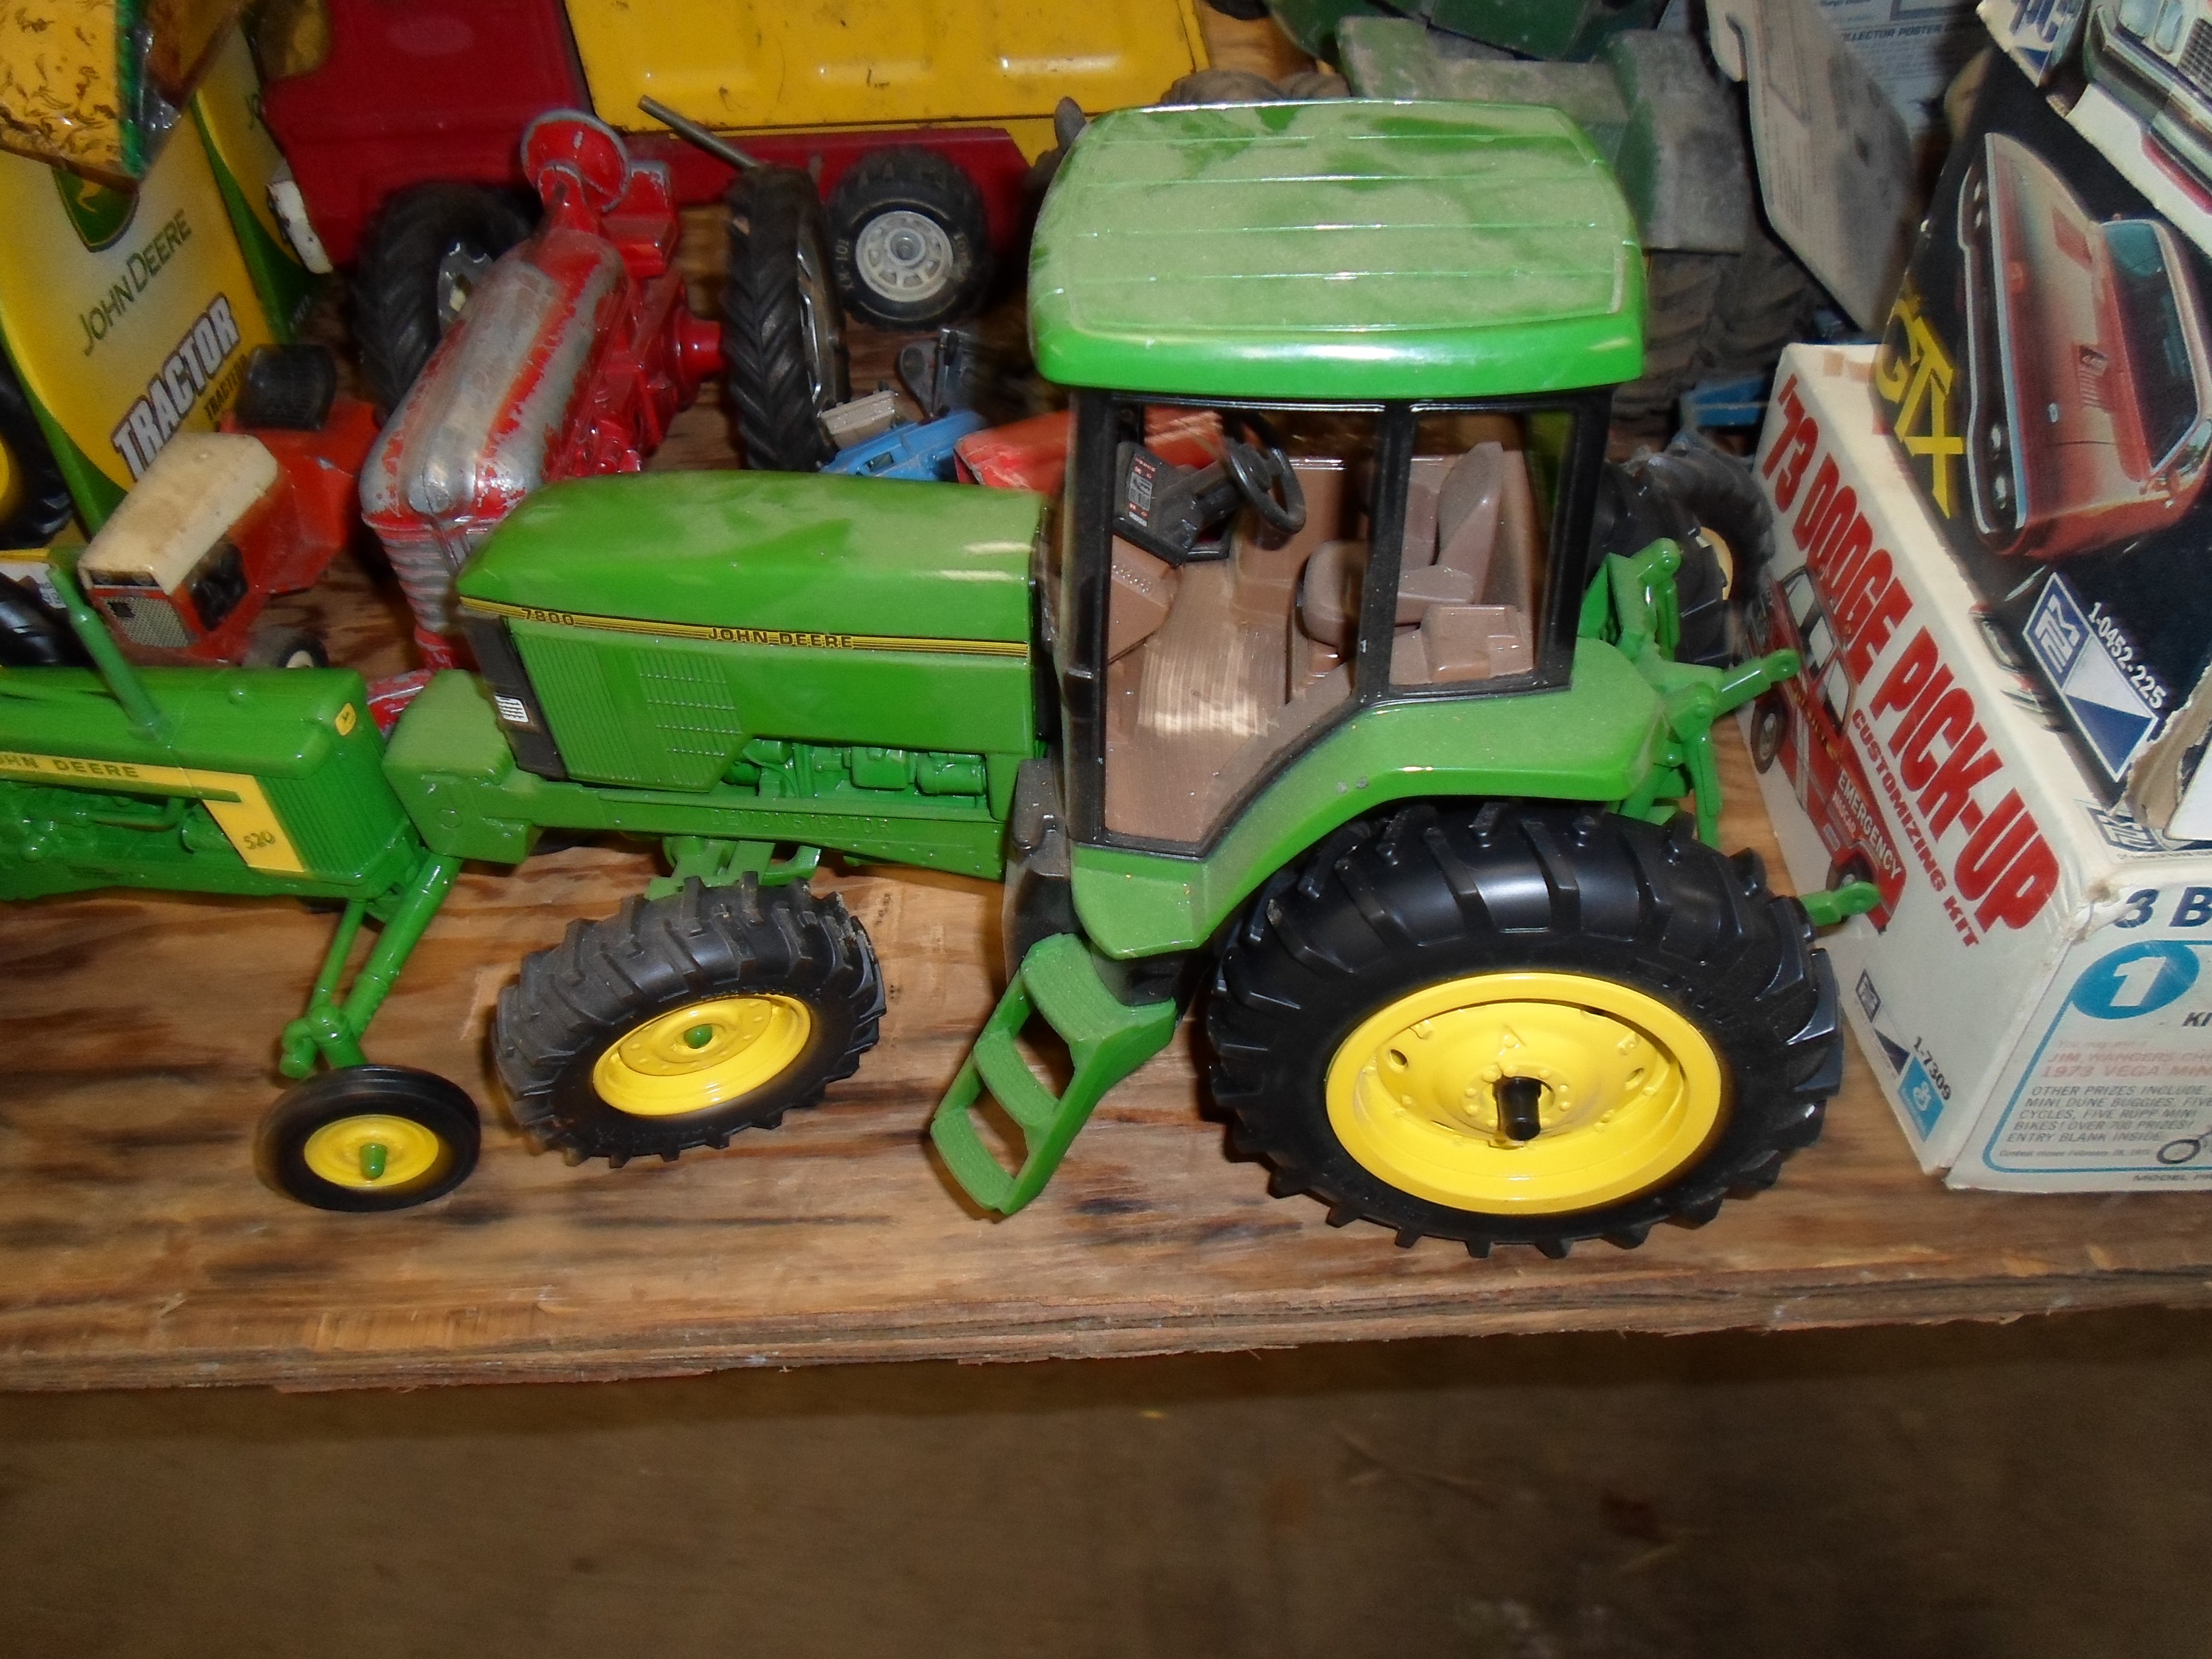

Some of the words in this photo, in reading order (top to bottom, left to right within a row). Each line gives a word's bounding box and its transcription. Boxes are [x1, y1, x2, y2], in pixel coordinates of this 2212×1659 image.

[79, 275, 134, 357] JOHN
[127, 208, 192, 292] DEERE
[110, 291, 240, 483] TRACTOR
[521, 608, 575, 626] 7800
[708, 627, 769, 643] JOHN
[780, 632, 854, 649] DEERE
[1762, 373, 1819, 514] '73
[1792, 452, 1913, 685] DODGE
[1869, 626, 2060, 933] PICK-UP
[52, 758, 139, 778] DEERE
[1838, 768, 1902, 880] EMERGENCY
[1851, 709, 1948, 893] CUSTOMIZING
[1942, 886, 1980, 948] KIT
[2113, 888, 2160, 928] 3
[2110, 956, 2167, 1007] 1
[1914, 1036, 1952, 1101] 1-7309
[2104, 1065, 2161, 1077] VEGA
[2024, 1098, 2062, 1107] MINI
[2066, 1097, 2107, 1107] DUNE
[2032, 1086, 2081, 1096] OTHER
[2084, 1085, 2137, 1096] PRIZES
[2140, 1085, 2207, 1095] INCLUDE
[2019, 1109, 2076, 1120] CYCLES,
[2083, 1109, 2116, 1119] FIVE
[2068, 1120, 2106, 1130] OVER
[2007, 1132, 2055, 1142] ENTRY
[2058, 1132, 2106, 1142] BLANK
[2112, 1131, 2162, 1142] INSIDE
